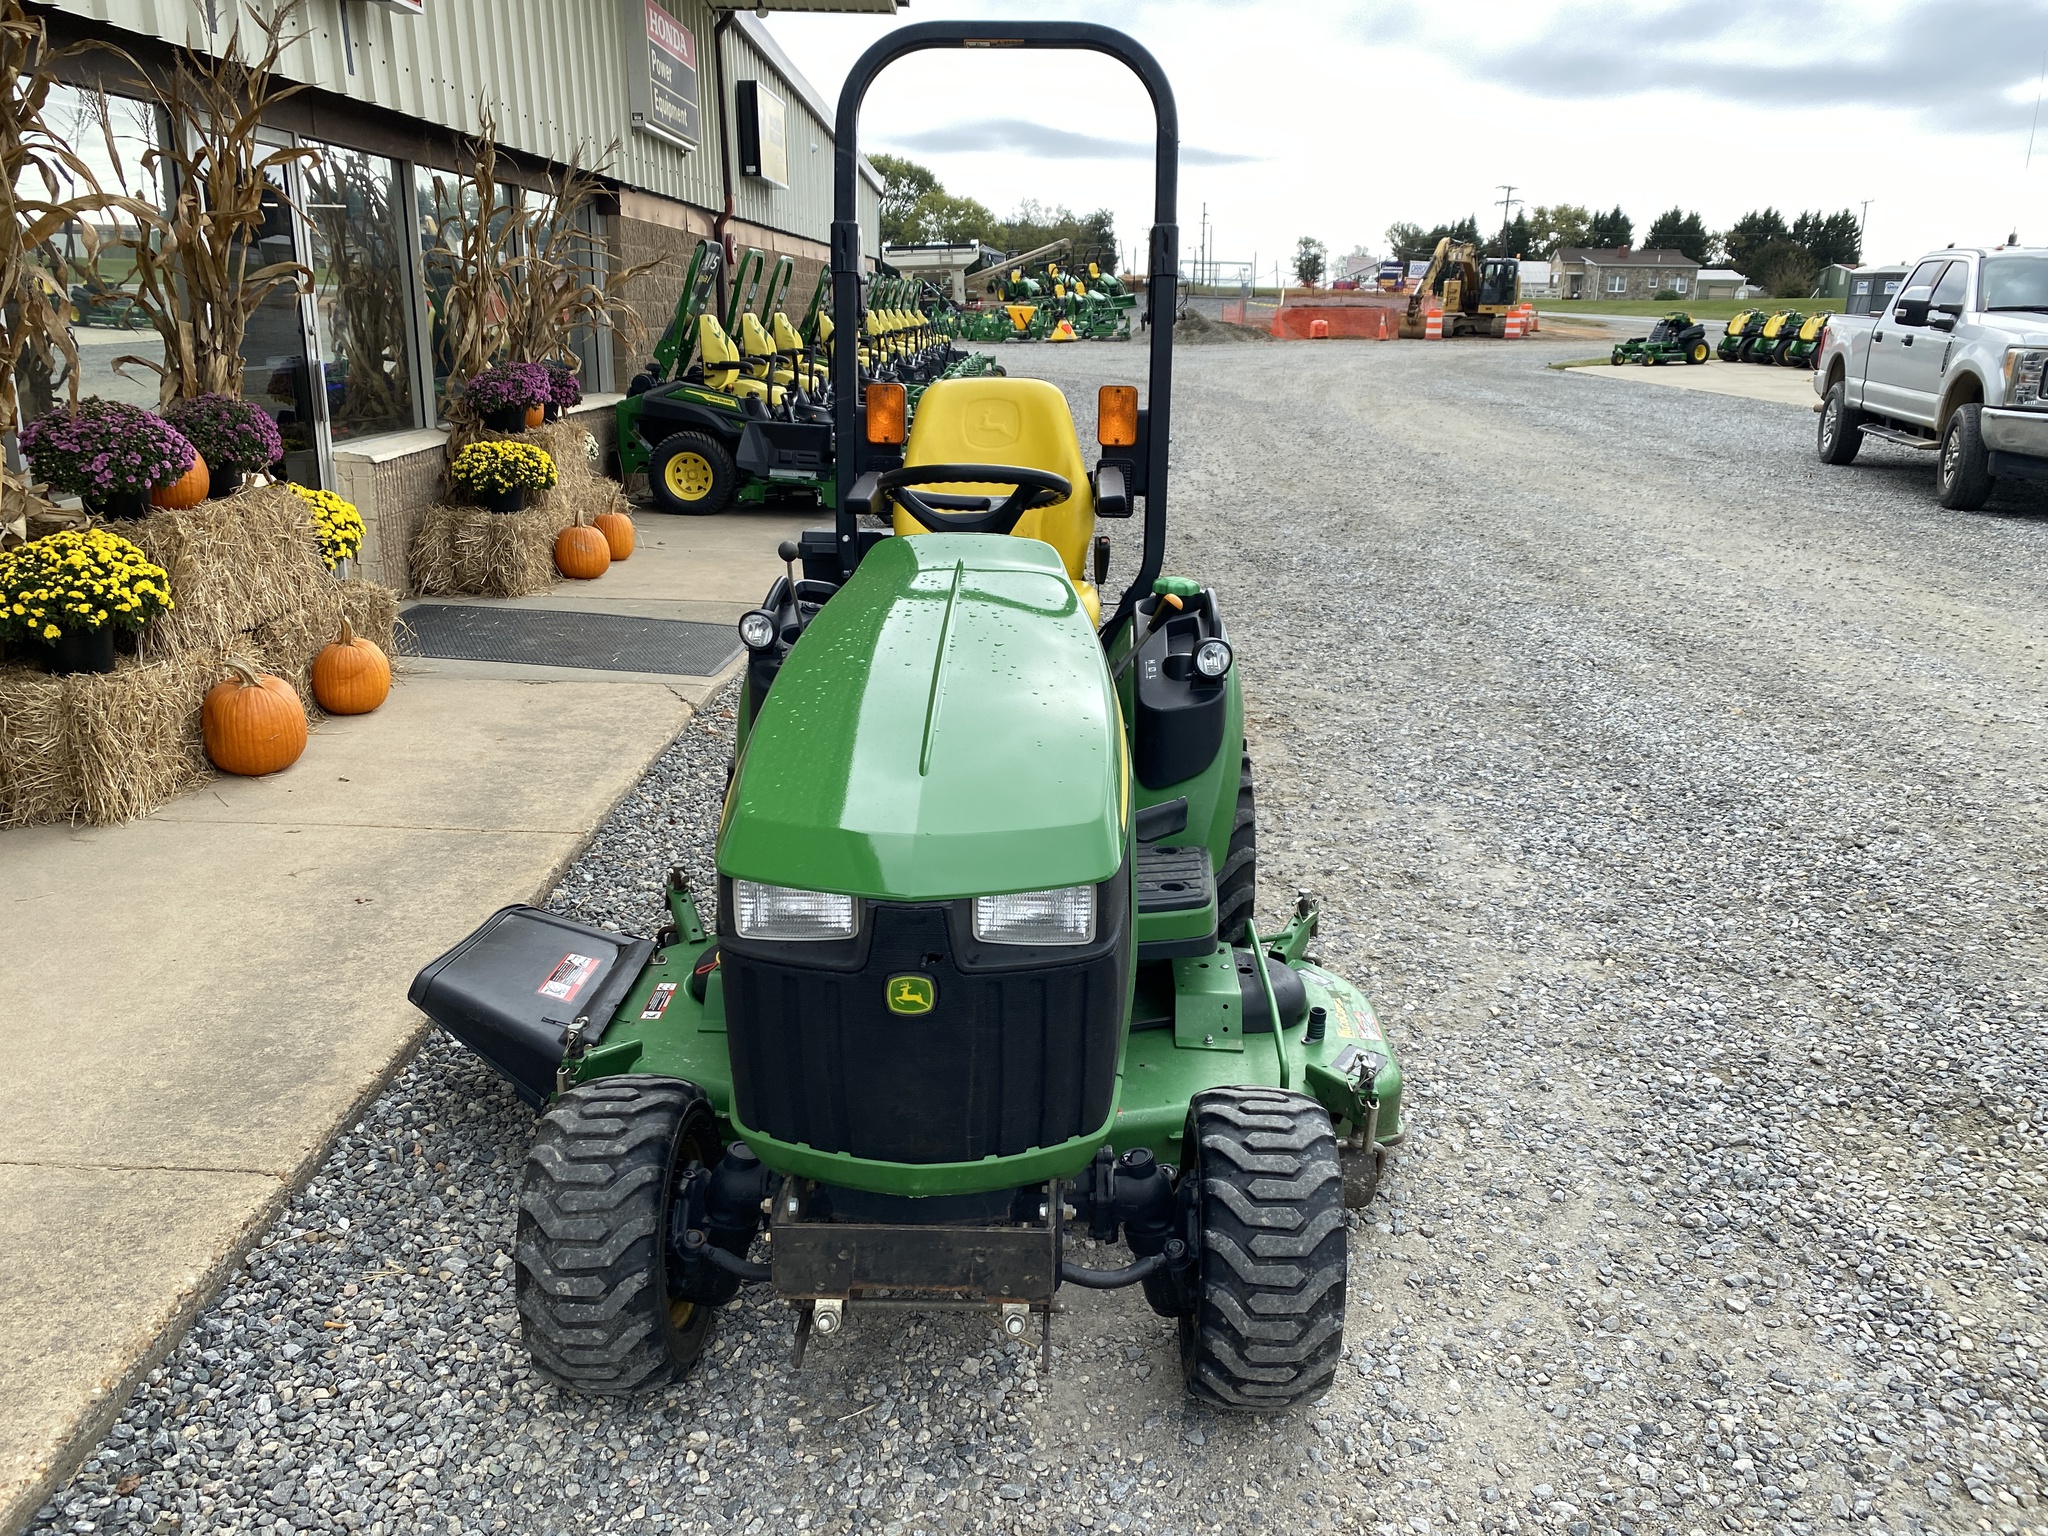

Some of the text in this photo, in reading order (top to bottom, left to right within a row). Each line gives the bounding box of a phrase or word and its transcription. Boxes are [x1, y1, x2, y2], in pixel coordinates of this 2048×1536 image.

[648, 7, 688, 58] HONDA
[651, 48, 672, 83] Power
[653, 87, 688, 126] Equipment
